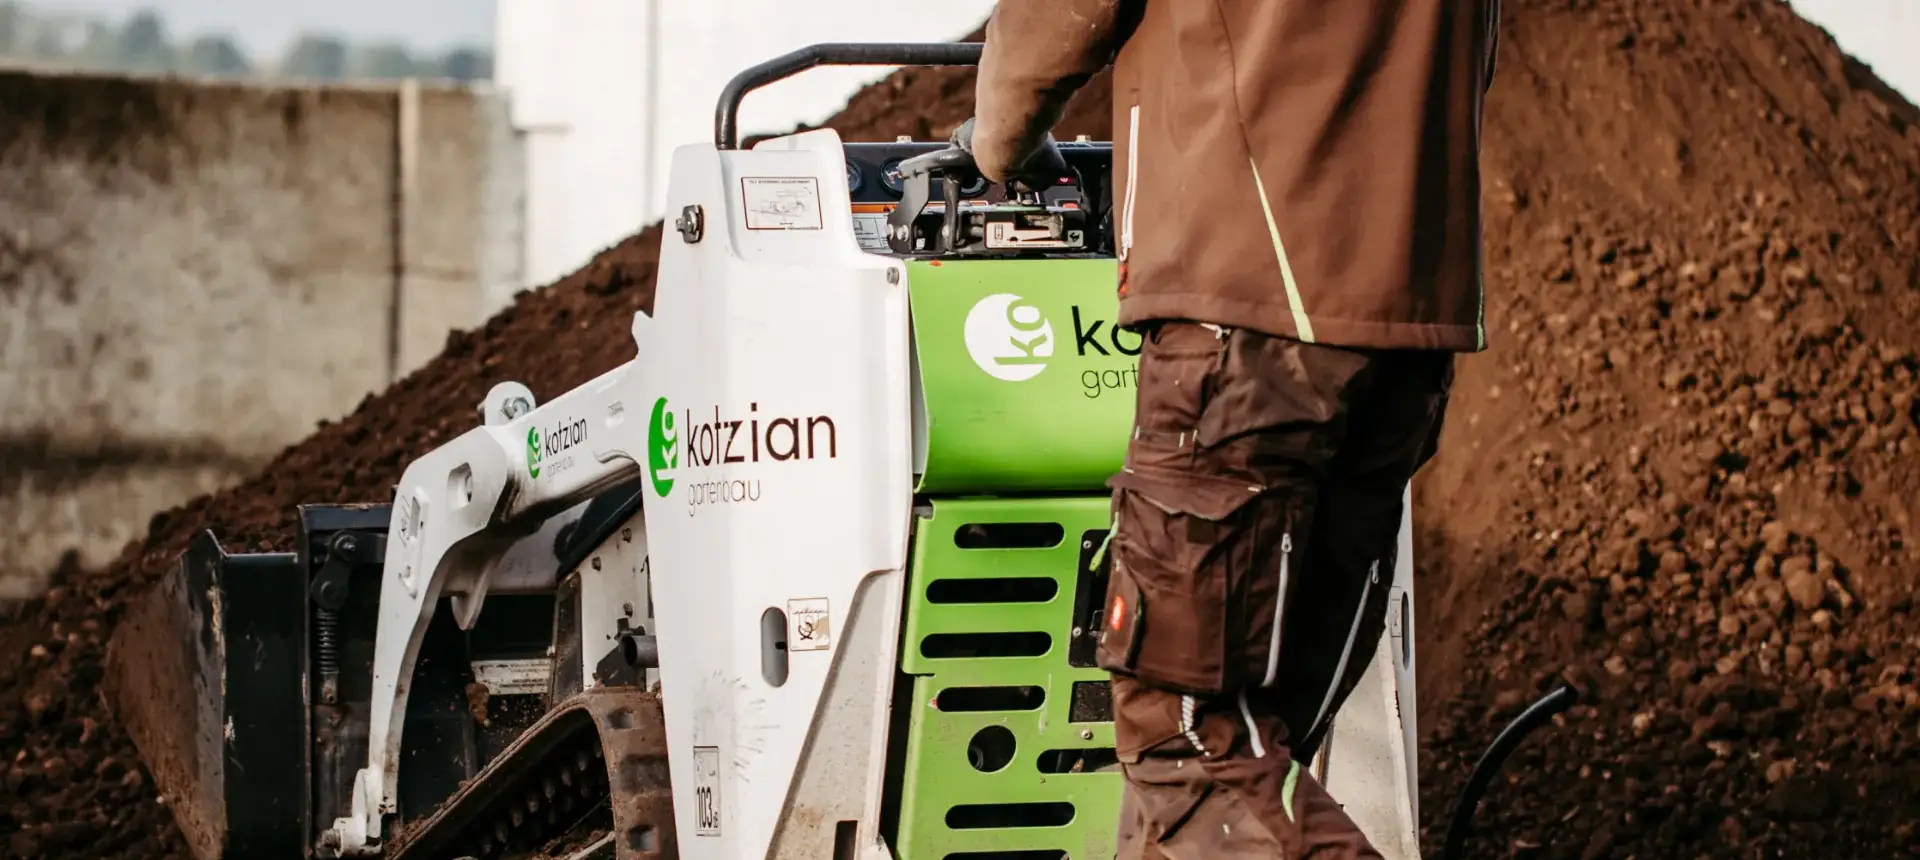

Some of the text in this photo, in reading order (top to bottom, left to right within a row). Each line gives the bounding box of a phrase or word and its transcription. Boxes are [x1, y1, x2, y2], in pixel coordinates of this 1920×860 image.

[1071, 305, 1144, 356] ko
[1081, 363, 1139, 399] gart
[544, 416, 588, 458] kotzian
[687, 402, 836, 467] kotzian
[687, 477, 761, 517] gartenbau
[696, 786, 712, 828] 103
